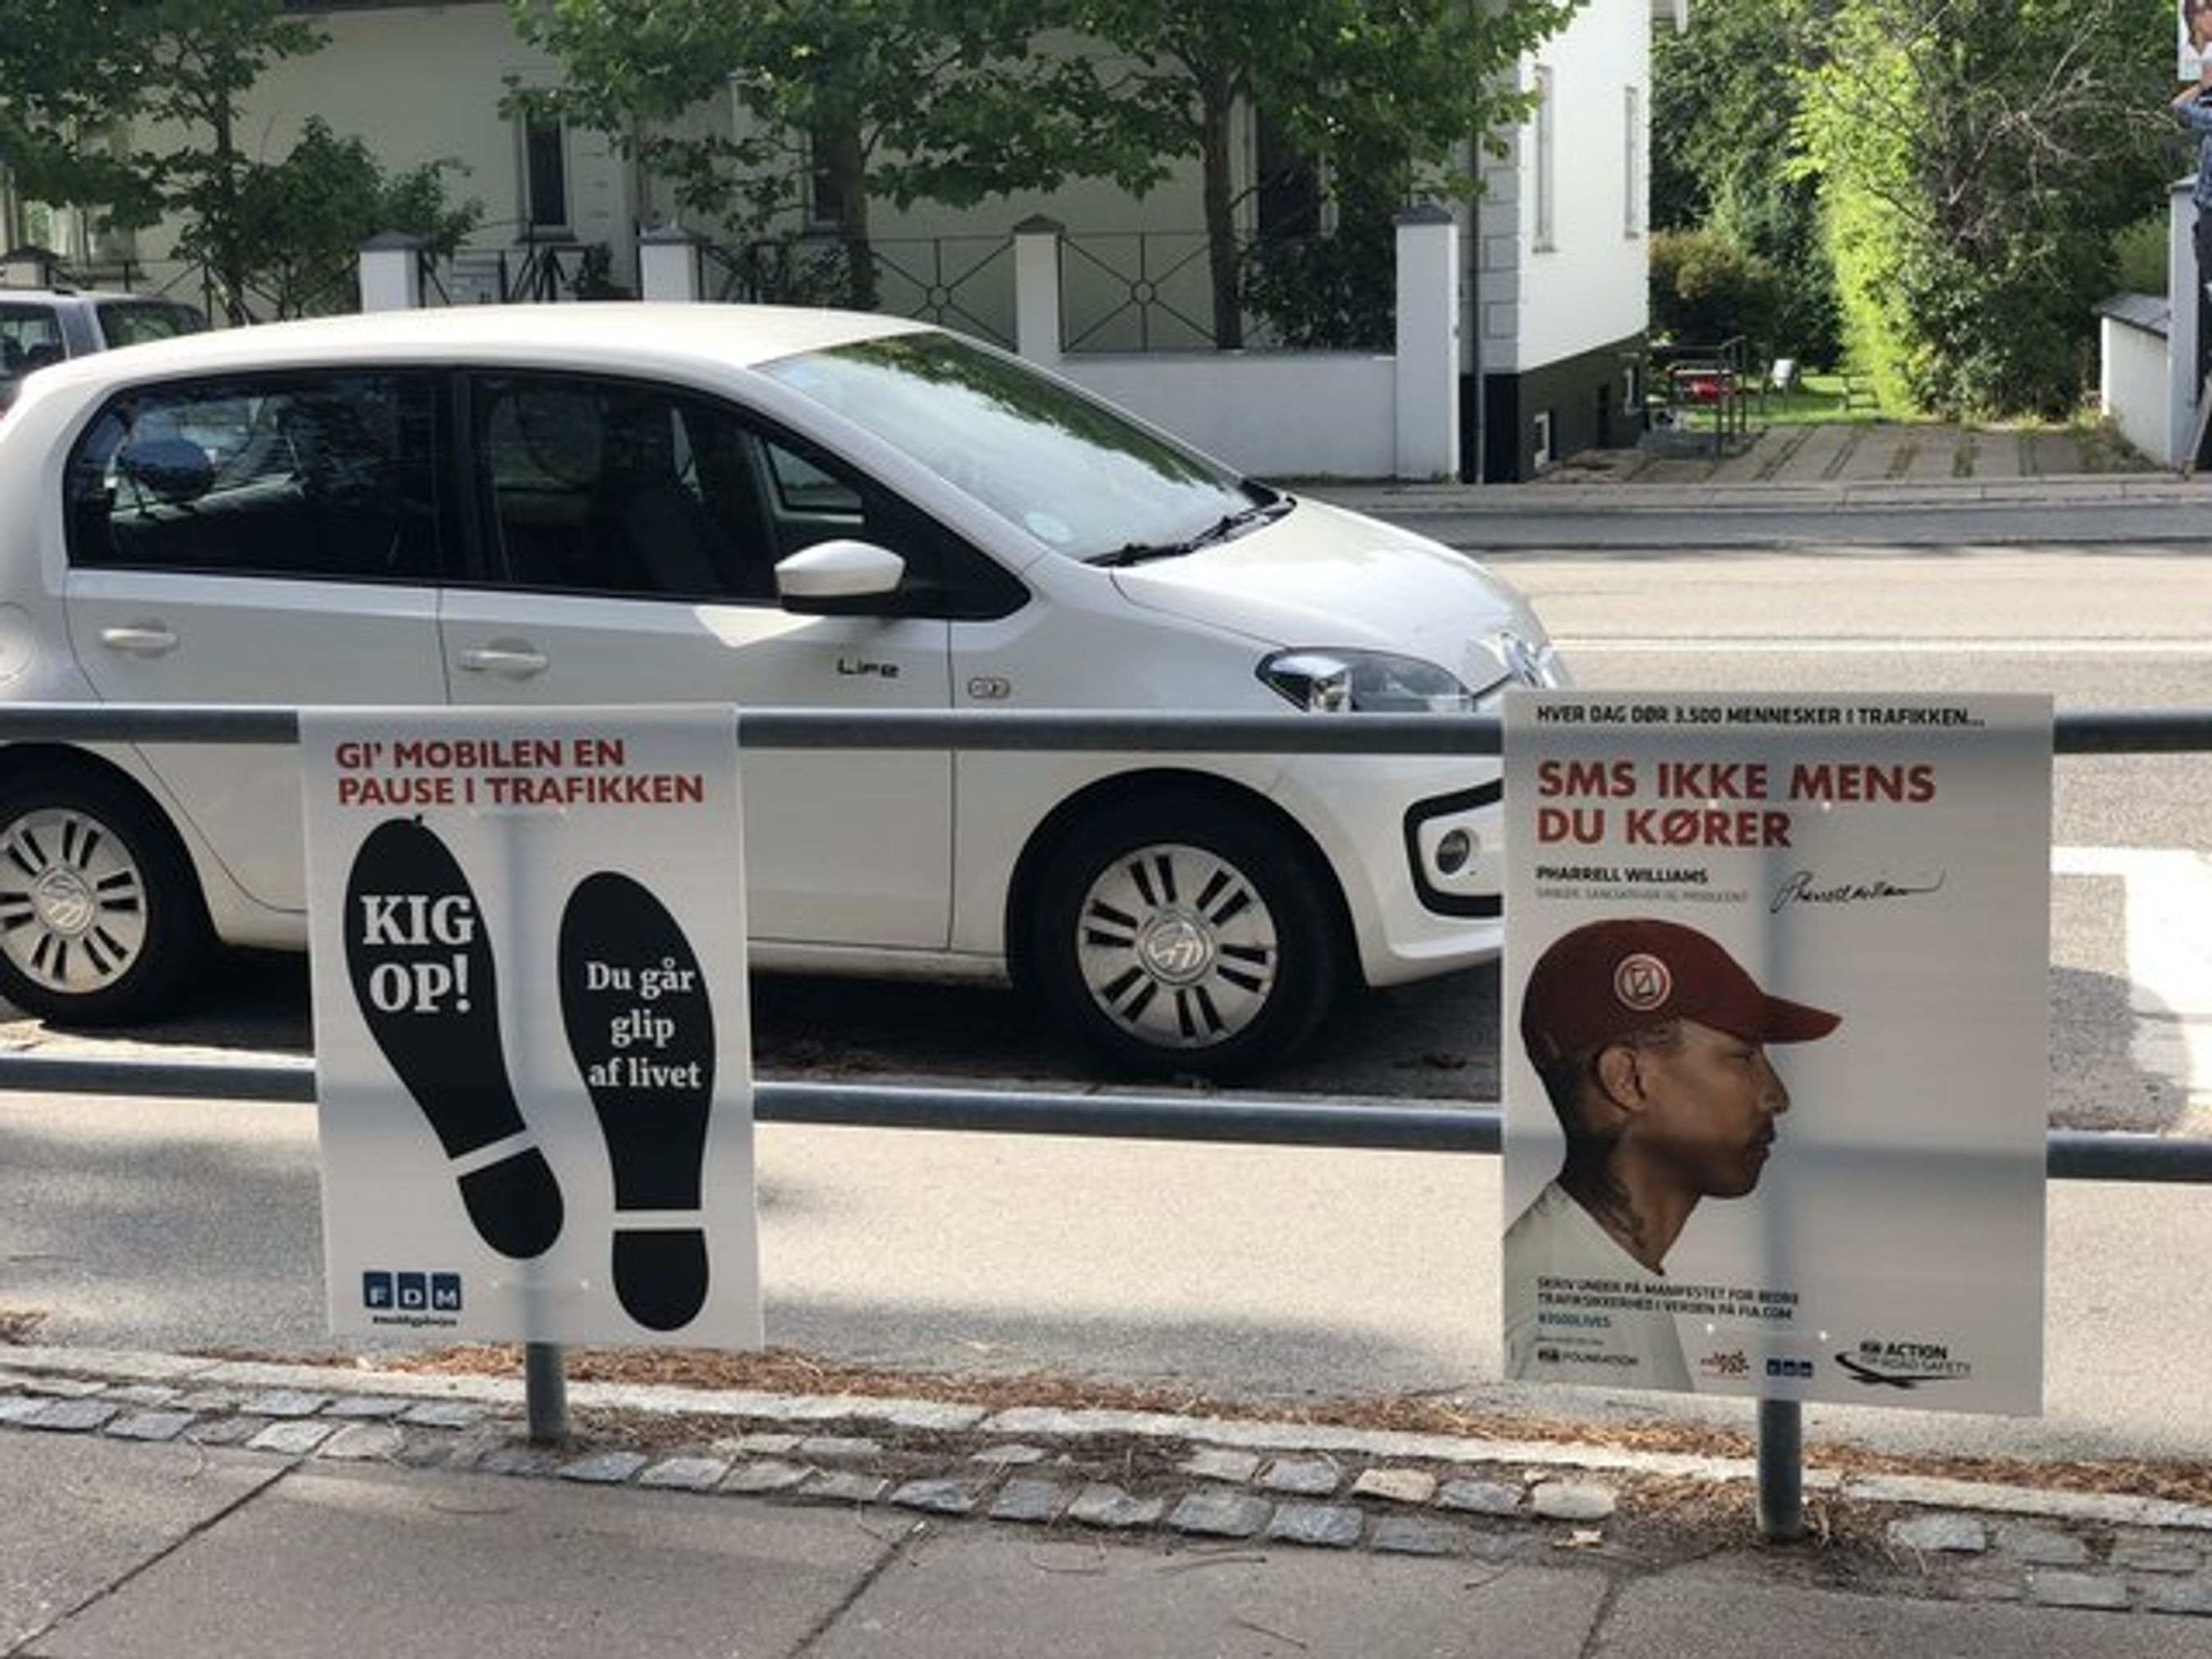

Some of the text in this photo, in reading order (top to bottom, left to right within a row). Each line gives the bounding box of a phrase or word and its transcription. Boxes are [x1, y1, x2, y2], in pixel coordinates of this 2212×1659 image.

[1537, 705, 1584, 723] HVER
[1589, 706, 1626, 724] DAG
[1630, 706, 1669, 724] DØR
[1675, 706, 1722, 724] 3.500
[1726, 706, 1841, 724] MENNESKER
[1847, 708, 1854, 724] I
[393, 740, 561, 768] MOBILEN
[576, 739, 625, 766] EN
[339, 775, 703, 805] PAUSE I TRAFIKKEN
[1538, 761, 1937, 803] SMS IKKE MENS
[1538, 807, 1792, 848] DU KØRER
[1536, 866, 1708, 884] PHARRELL WILLIAMS
[359, 895, 474, 945] KIG
[369, 954, 471, 1012] OP!
[586, 957, 695, 1000] Du går
[610, 1008, 675, 1049] glip
[588, 1057, 702, 1089] af livet
[368, 1282, 459, 1309] FDM
[1886, 1342, 1948, 1360] ACTION
